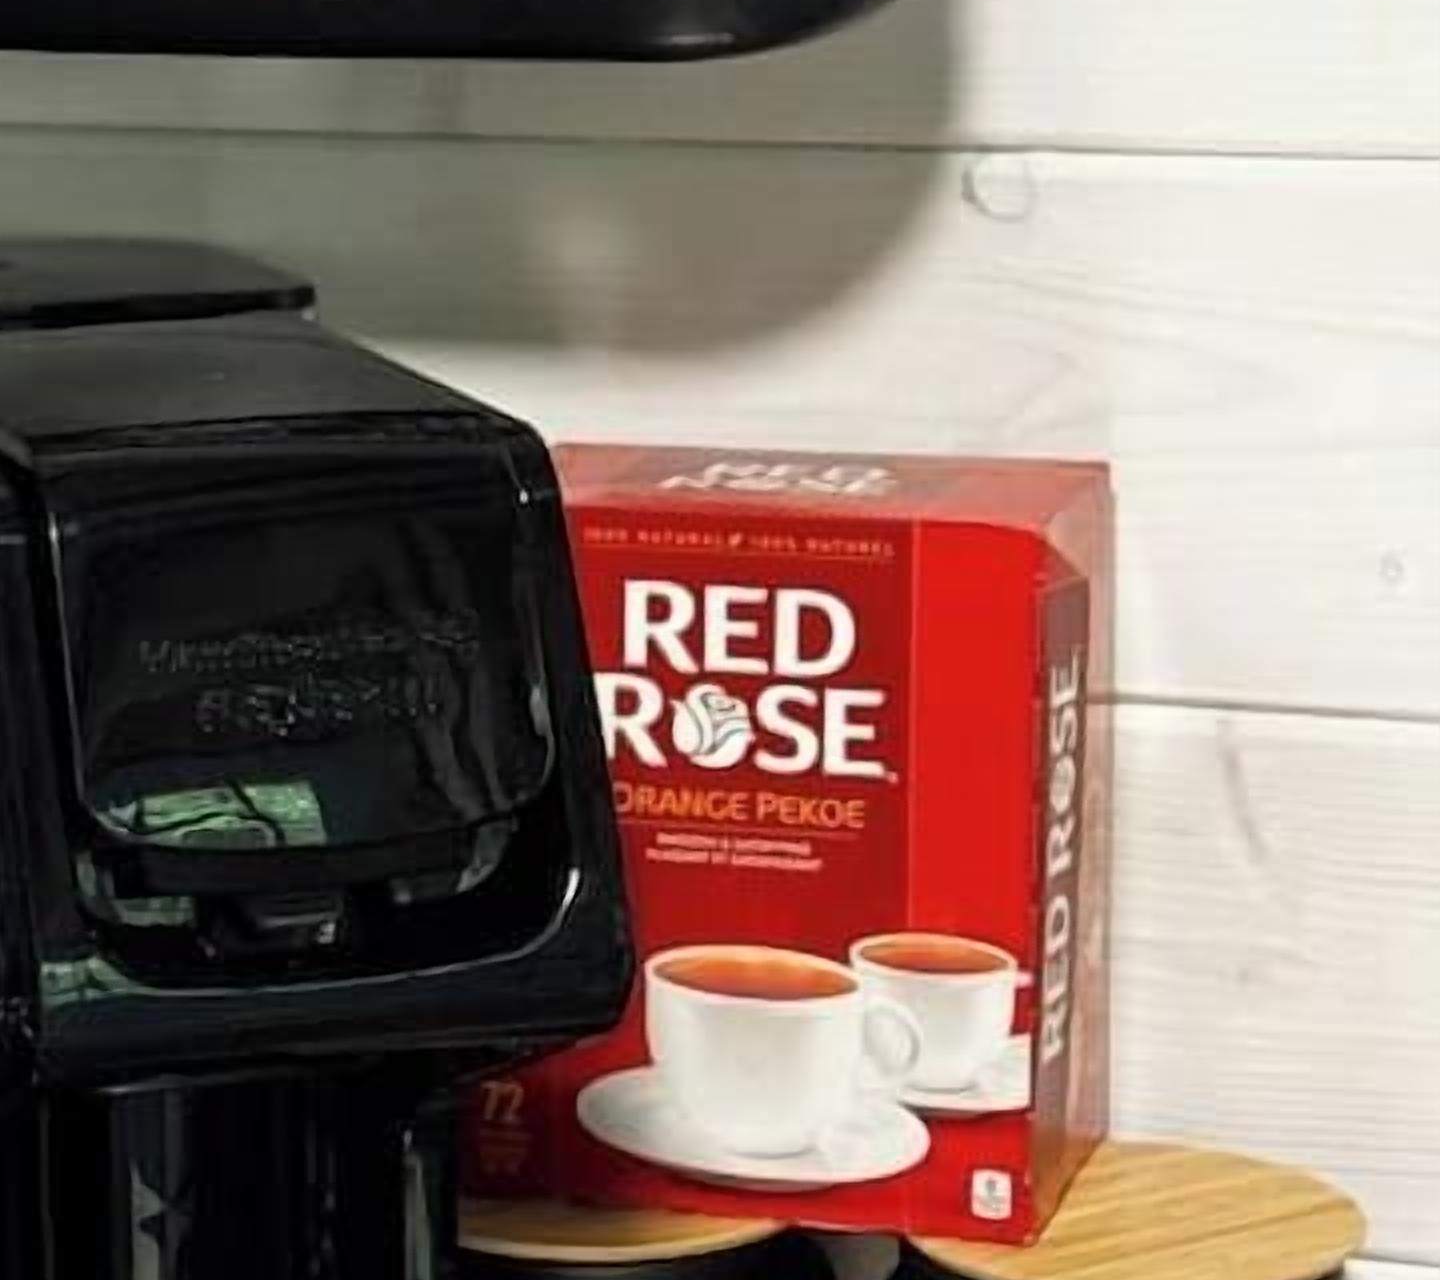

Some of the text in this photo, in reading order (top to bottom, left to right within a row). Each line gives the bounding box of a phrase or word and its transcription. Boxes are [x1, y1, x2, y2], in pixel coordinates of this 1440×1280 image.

[623, 578, 856, 678] RED
[593, 671, 886, 777] ROSE
[1043, 646, 1081, 880] ROSE
[612, 780, 866, 830] ORANGE PEKOE
